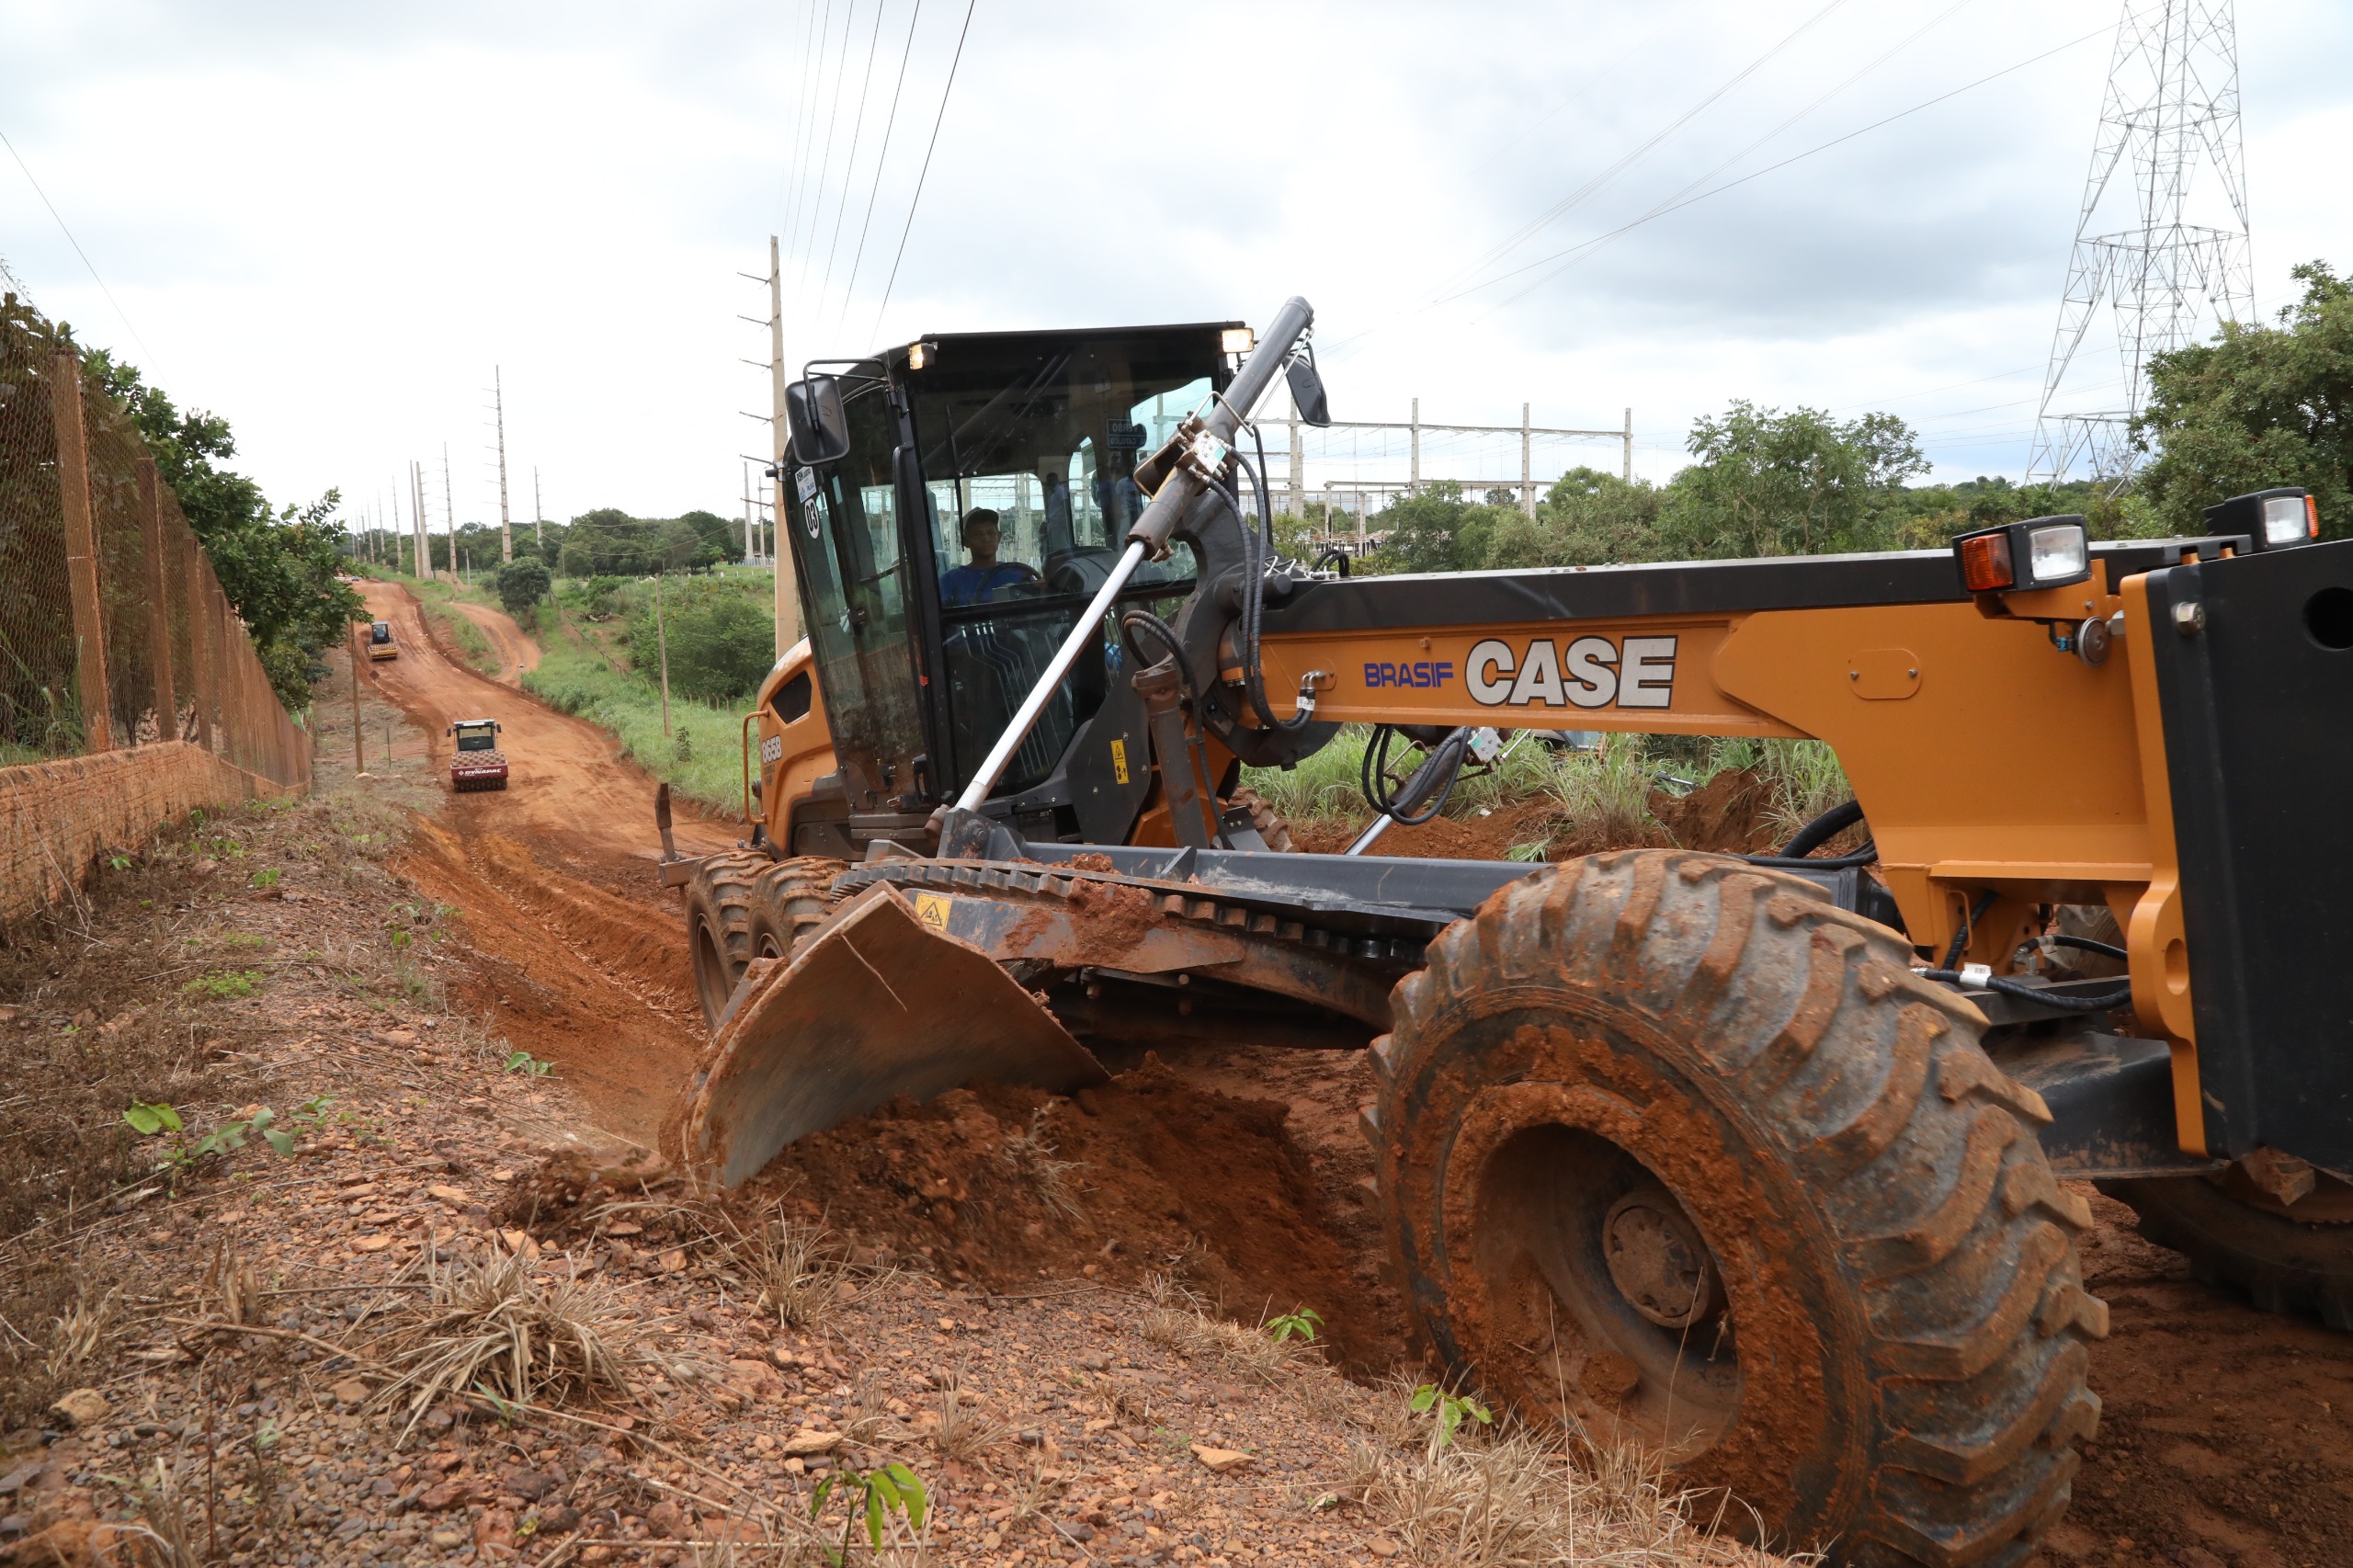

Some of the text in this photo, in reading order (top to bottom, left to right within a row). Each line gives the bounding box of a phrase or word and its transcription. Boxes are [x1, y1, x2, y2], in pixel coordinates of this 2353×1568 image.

[806, 502, 818, 532] 03
[1364, 662, 1454, 688] BRASIF
[1464, 634, 1678, 710] CASE
